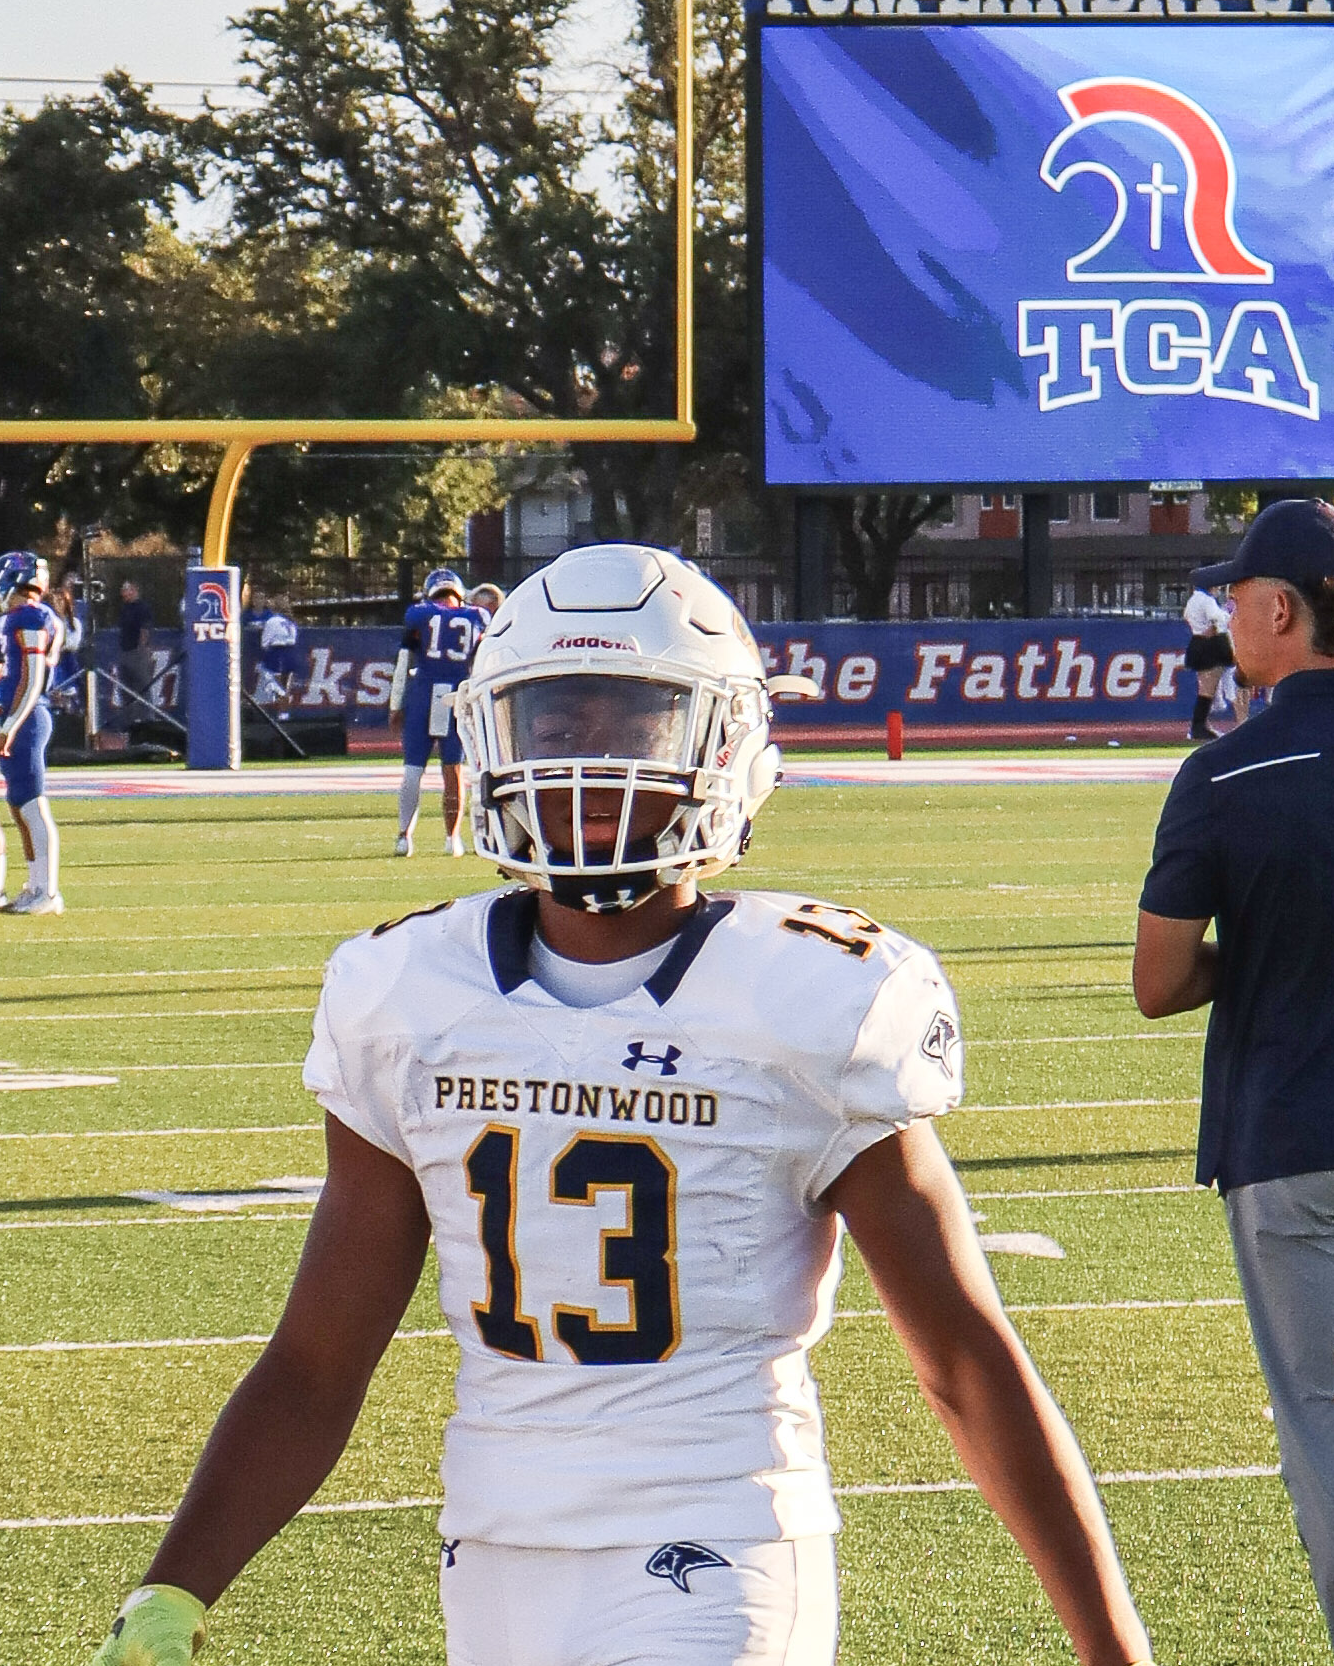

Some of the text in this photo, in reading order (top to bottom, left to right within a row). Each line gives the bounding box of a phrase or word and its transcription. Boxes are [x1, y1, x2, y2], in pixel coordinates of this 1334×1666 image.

[1018, 298, 1320, 420] TCA
[425, 613, 475, 662] 13
[906, 637, 1186, 703] Father
[434, 1077, 718, 1127] PRESTONWOOD
[464, 1122, 682, 1365] 13
